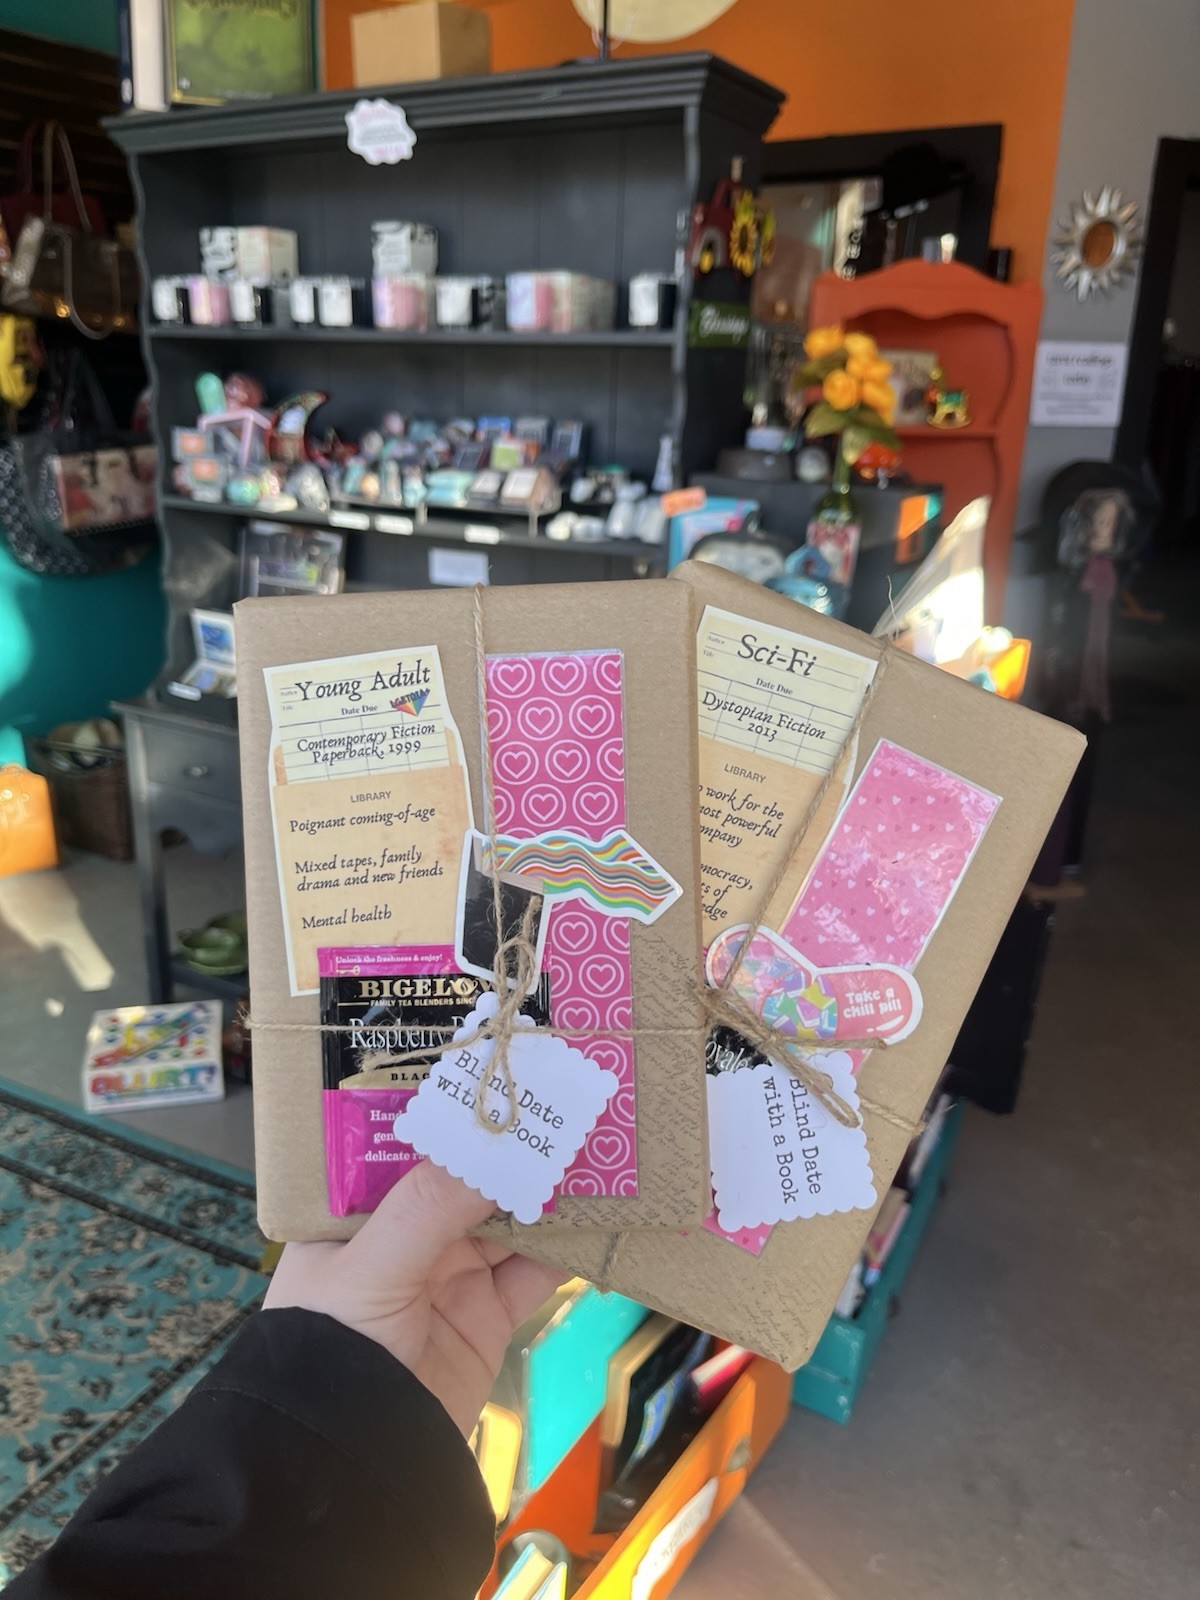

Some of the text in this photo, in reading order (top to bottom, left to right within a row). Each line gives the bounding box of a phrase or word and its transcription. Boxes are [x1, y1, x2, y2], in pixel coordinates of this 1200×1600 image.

[737, 634, 817, 677] Sci-Fi
[294, 659, 431, 701] Young Adult
[756, 677, 793, 695] Date Due
[341, 705, 378, 716] Date Due
[702, 690, 826, 740] Dystopian Fiction
[297, 724, 436, 752] Contemporary Fiction
[747, 722, 778, 743] 2013
[313, 740, 421, 766] Paperback, 1999
[724, 763, 766, 784] LIBRARY
[350, 790, 391, 803] LIBRARY
[706, 788, 737, 811] work
[737, 793, 760, 811] for
[763, 802, 784, 820] the
[289, 803, 436, 835] Poignant coming-of-age
[721, 812, 782, 838] powerful
[700, 824, 743, 848] mpany
[295, 845, 422, 874] Mixed tapes, family
[297, 861, 443, 891] drama and new friends
[700, 863, 753, 891] mocracy,
[713, 884, 732, 903] of
[302, 904, 392, 929] Mental health
[700, 899, 728, 921] edge
[335, 953, 443, 964] Unlock the freshness & enjoy!
[370, 997, 474, 1007] FAMILY TEA BLENDERS SINC
[843, 998, 902, 1018] chill pill
[845, 987, 895, 1005] Take a
[705, 1041, 749, 1072] oyale
[391, 1072, 430, 1081] BLAC
[454, 1049, 564, 1129] Blnd Date
[488, 1109, 501, 1124] a
[373, 1132, 395, 1144] gen
[763, 1076, 799, 1204] with a Book
[364, 1150, 411, 1161] delicate
[802, 1146, 822, 1195] Date
